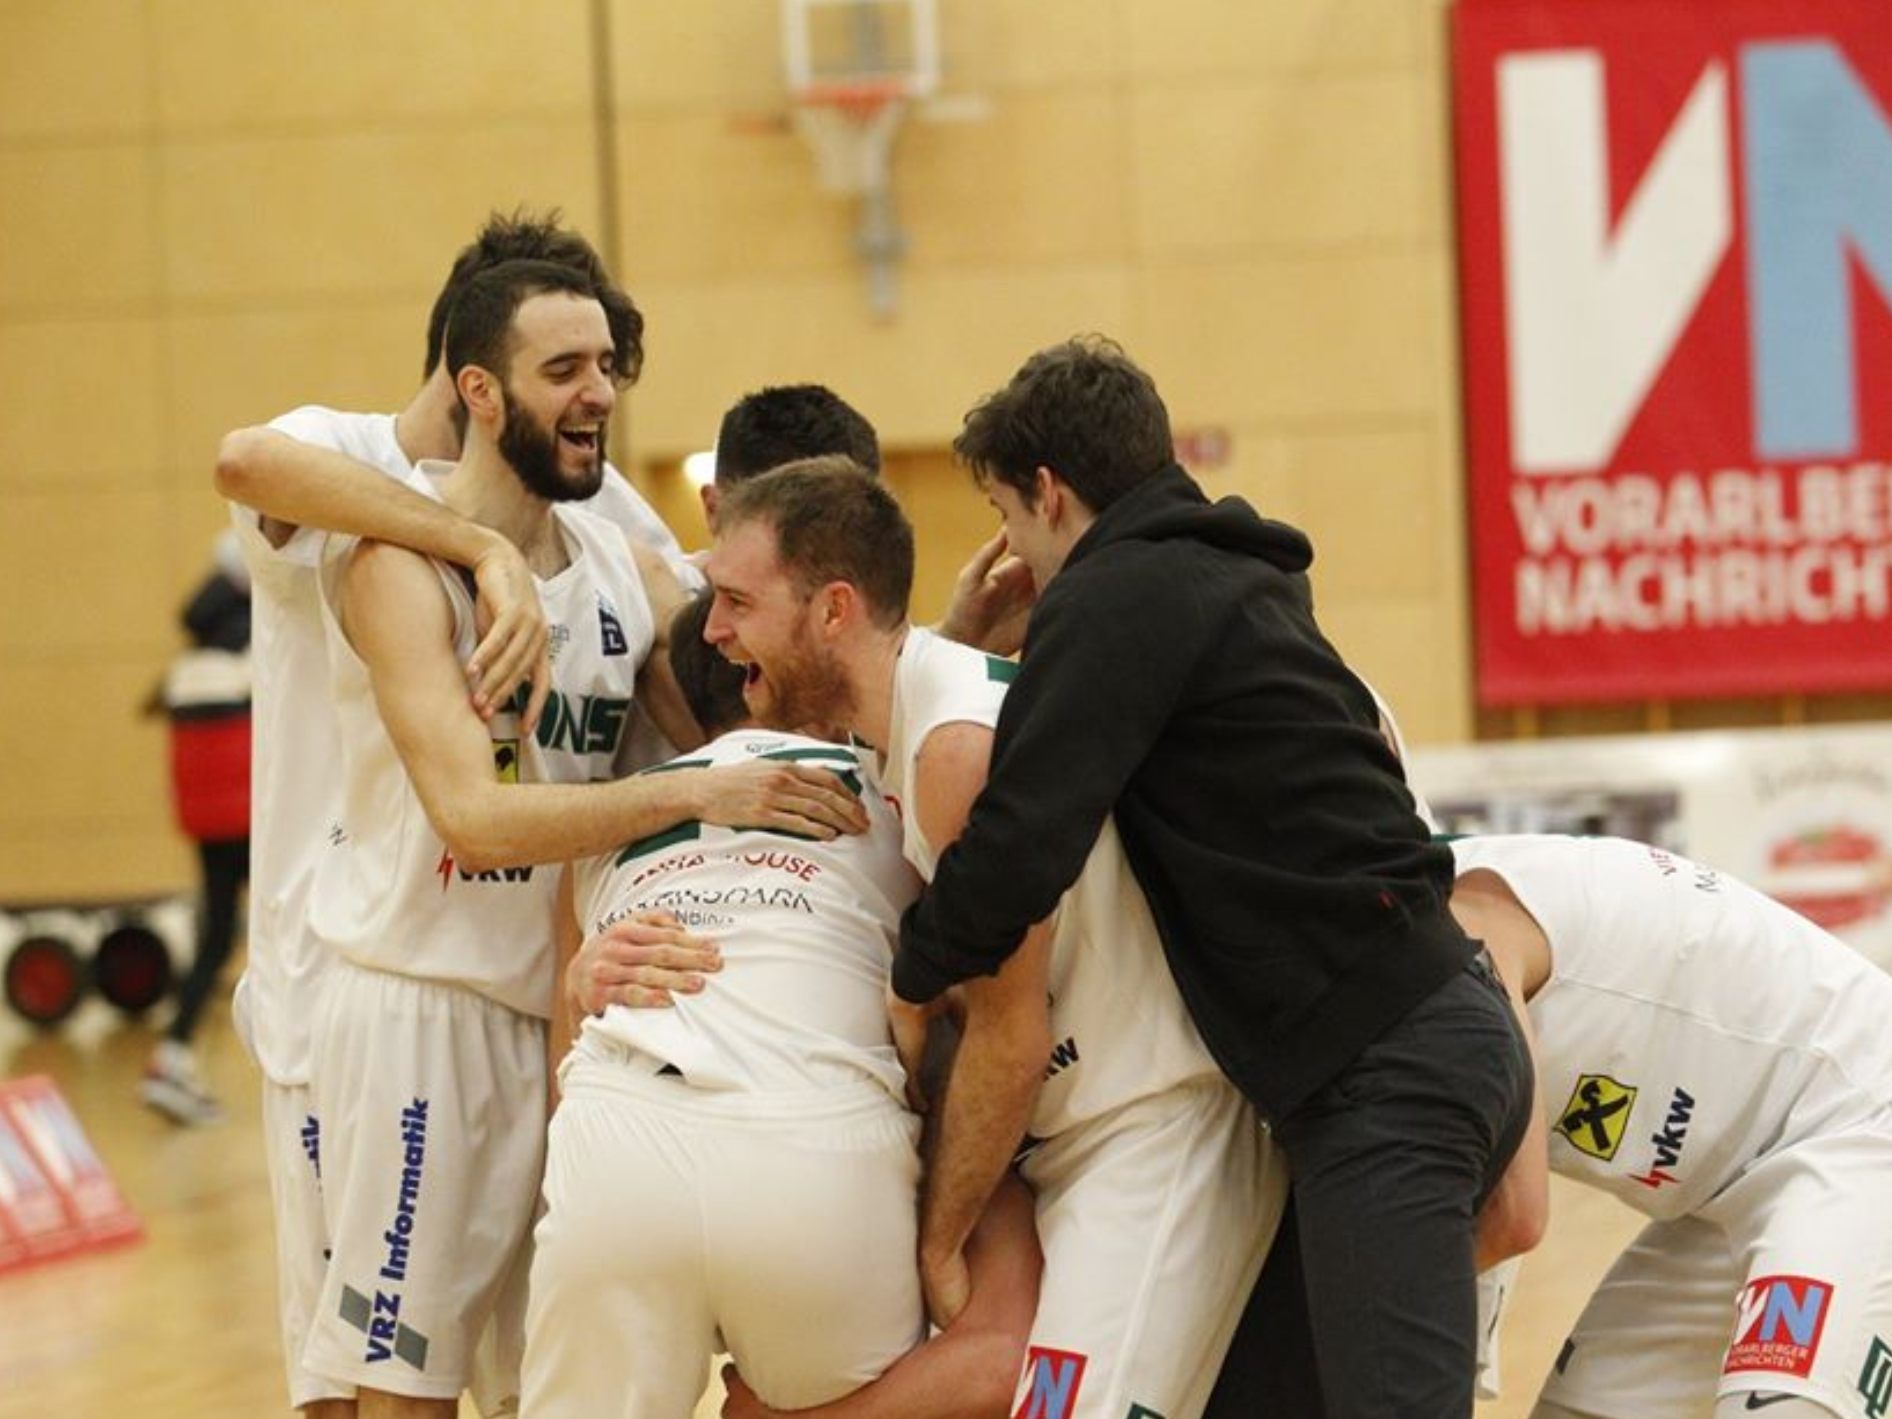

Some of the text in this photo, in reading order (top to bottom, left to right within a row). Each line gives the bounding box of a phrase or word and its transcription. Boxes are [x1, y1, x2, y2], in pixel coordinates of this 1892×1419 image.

[1510, 462, 1892, 556] VORARLBE
[1515, 540, 1892, 636] NACHRICH
[1651, 1087, 1695, 1166] vkw
[364, 1097, 428, 1363] VRZ Informatik
